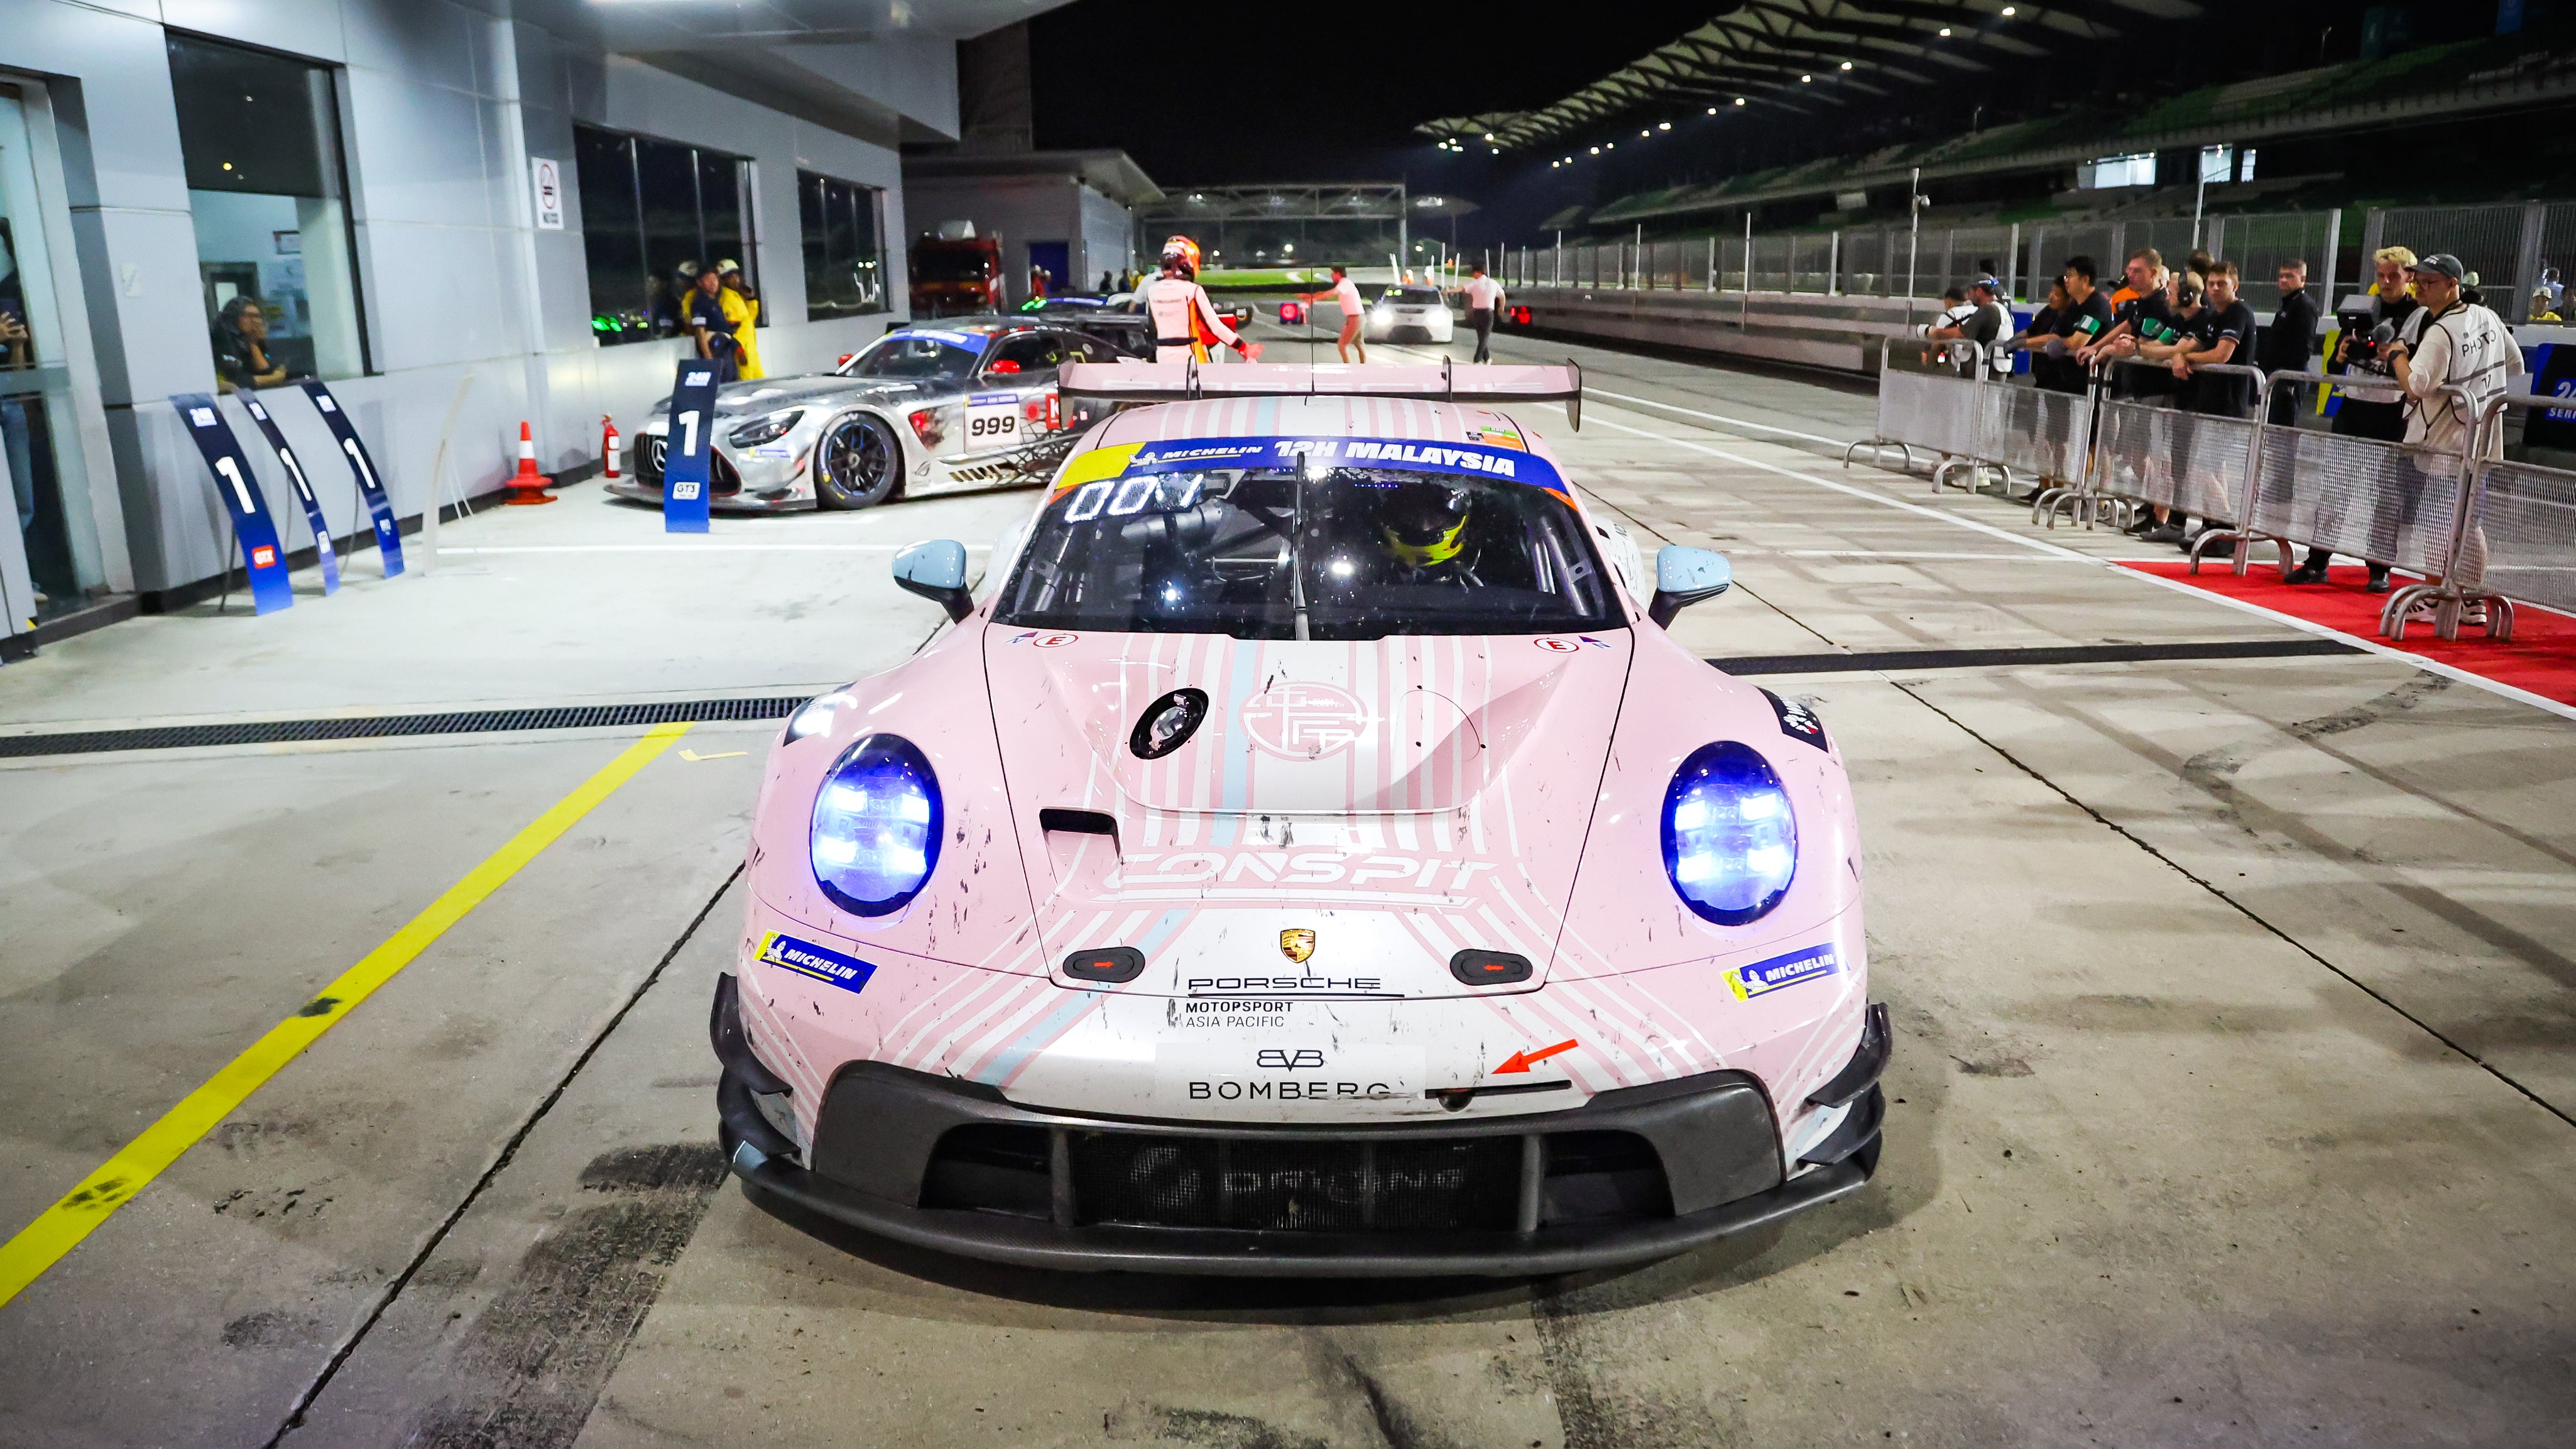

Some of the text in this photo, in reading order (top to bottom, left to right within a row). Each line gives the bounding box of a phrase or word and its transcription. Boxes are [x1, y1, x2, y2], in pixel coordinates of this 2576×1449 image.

[2462, 329, 2496, 357] PHOTO
[679, 410, 700, 456] 1
[971, 415, 1015, 437] 999
[280, 447, 312, 501] 1
[343, 438, 376, 489] 1
[1162, 441, 1516, 478] MICHELIN 12H MALAYSIA
[215, 456, 256, 514] 1
[1045, 637, 1067, 645] E
[1546, 641, 1568, 650] E
[1103, 851, 1499, 890] CONSPIT
[784, 949, 858, 980] MICHELIN
[1765, 953, 1835, 982] MICHELIN
[1188, 977, 1381, 990] PORSCHE
[1186, 1016, 1284, 1027] ASIA PACIFIC
[1189, 1081, 1391, 1100] BOMBERG
